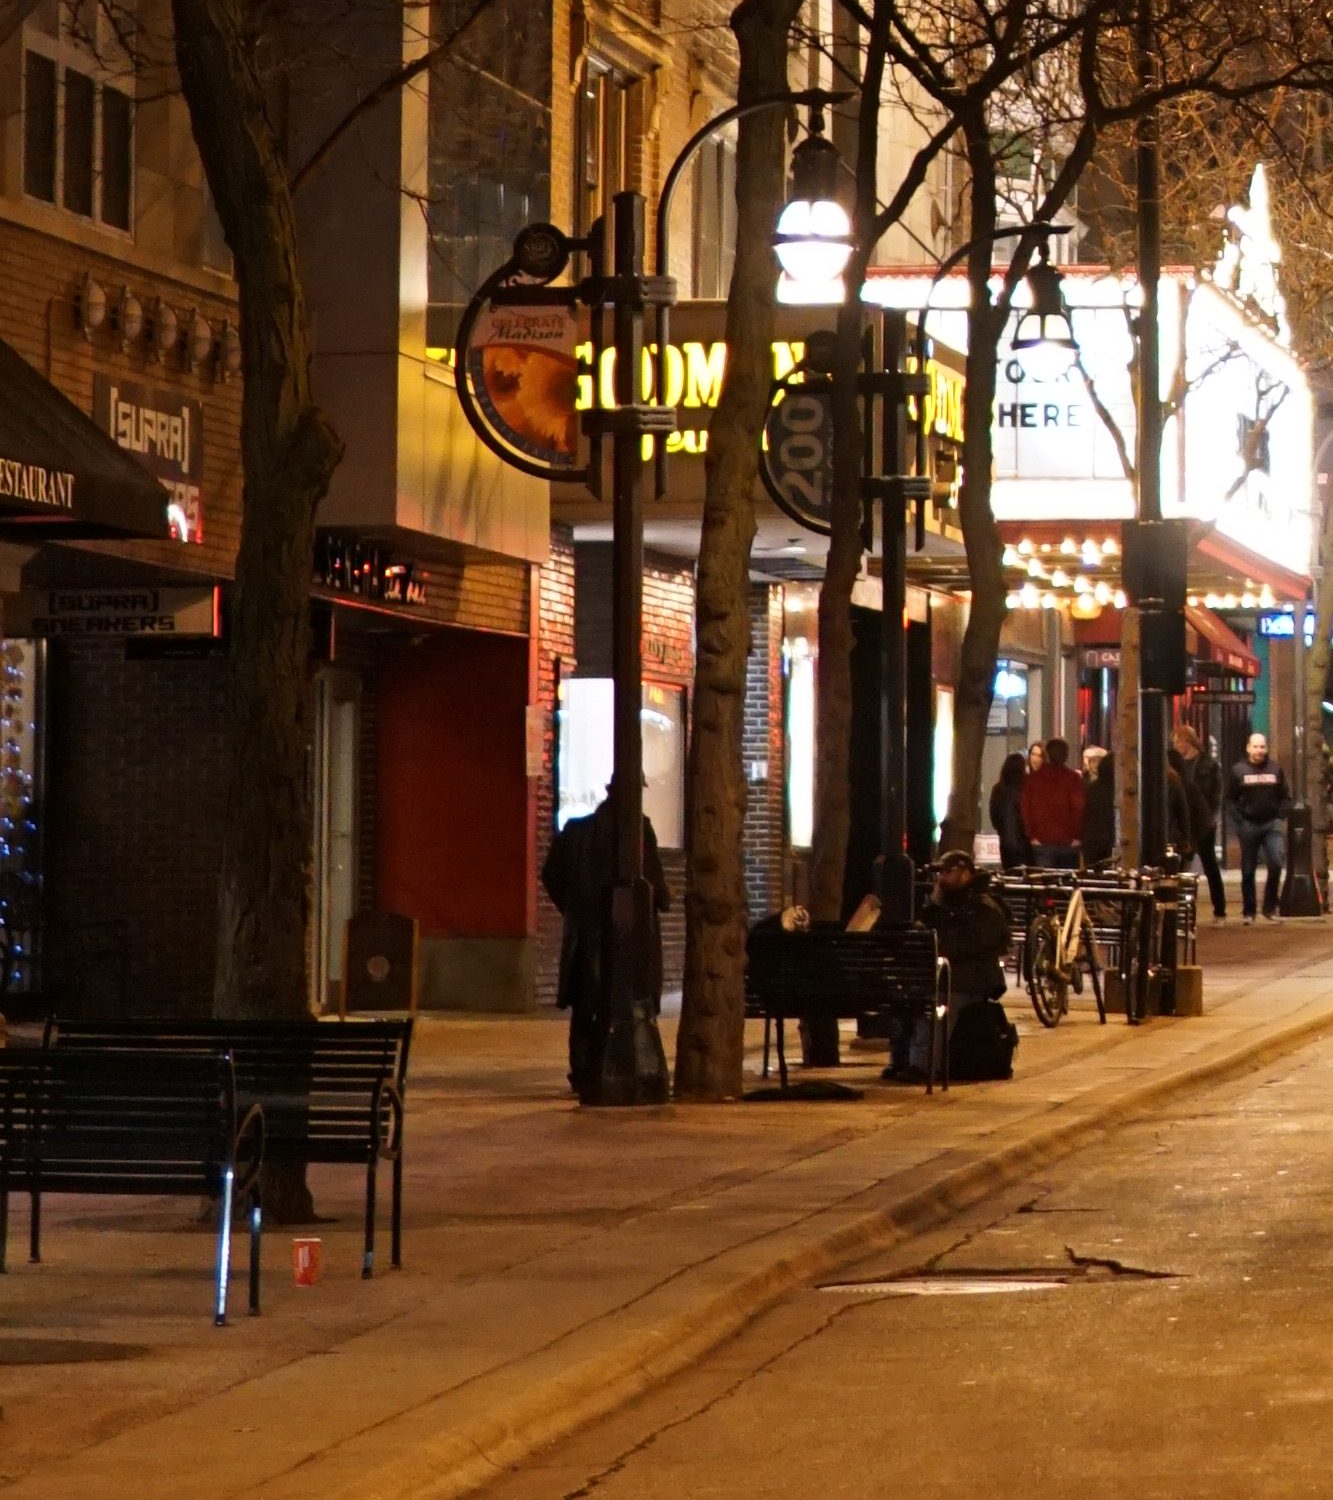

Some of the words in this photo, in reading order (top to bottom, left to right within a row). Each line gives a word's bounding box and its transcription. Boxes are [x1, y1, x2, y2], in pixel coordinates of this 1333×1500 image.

[488, 325, 565, 342] Madison
[998, 402, 1082, 428] HERE
[780, 396, 824, 506] 200
[0, 458, 75, 509] ESTAURANT
